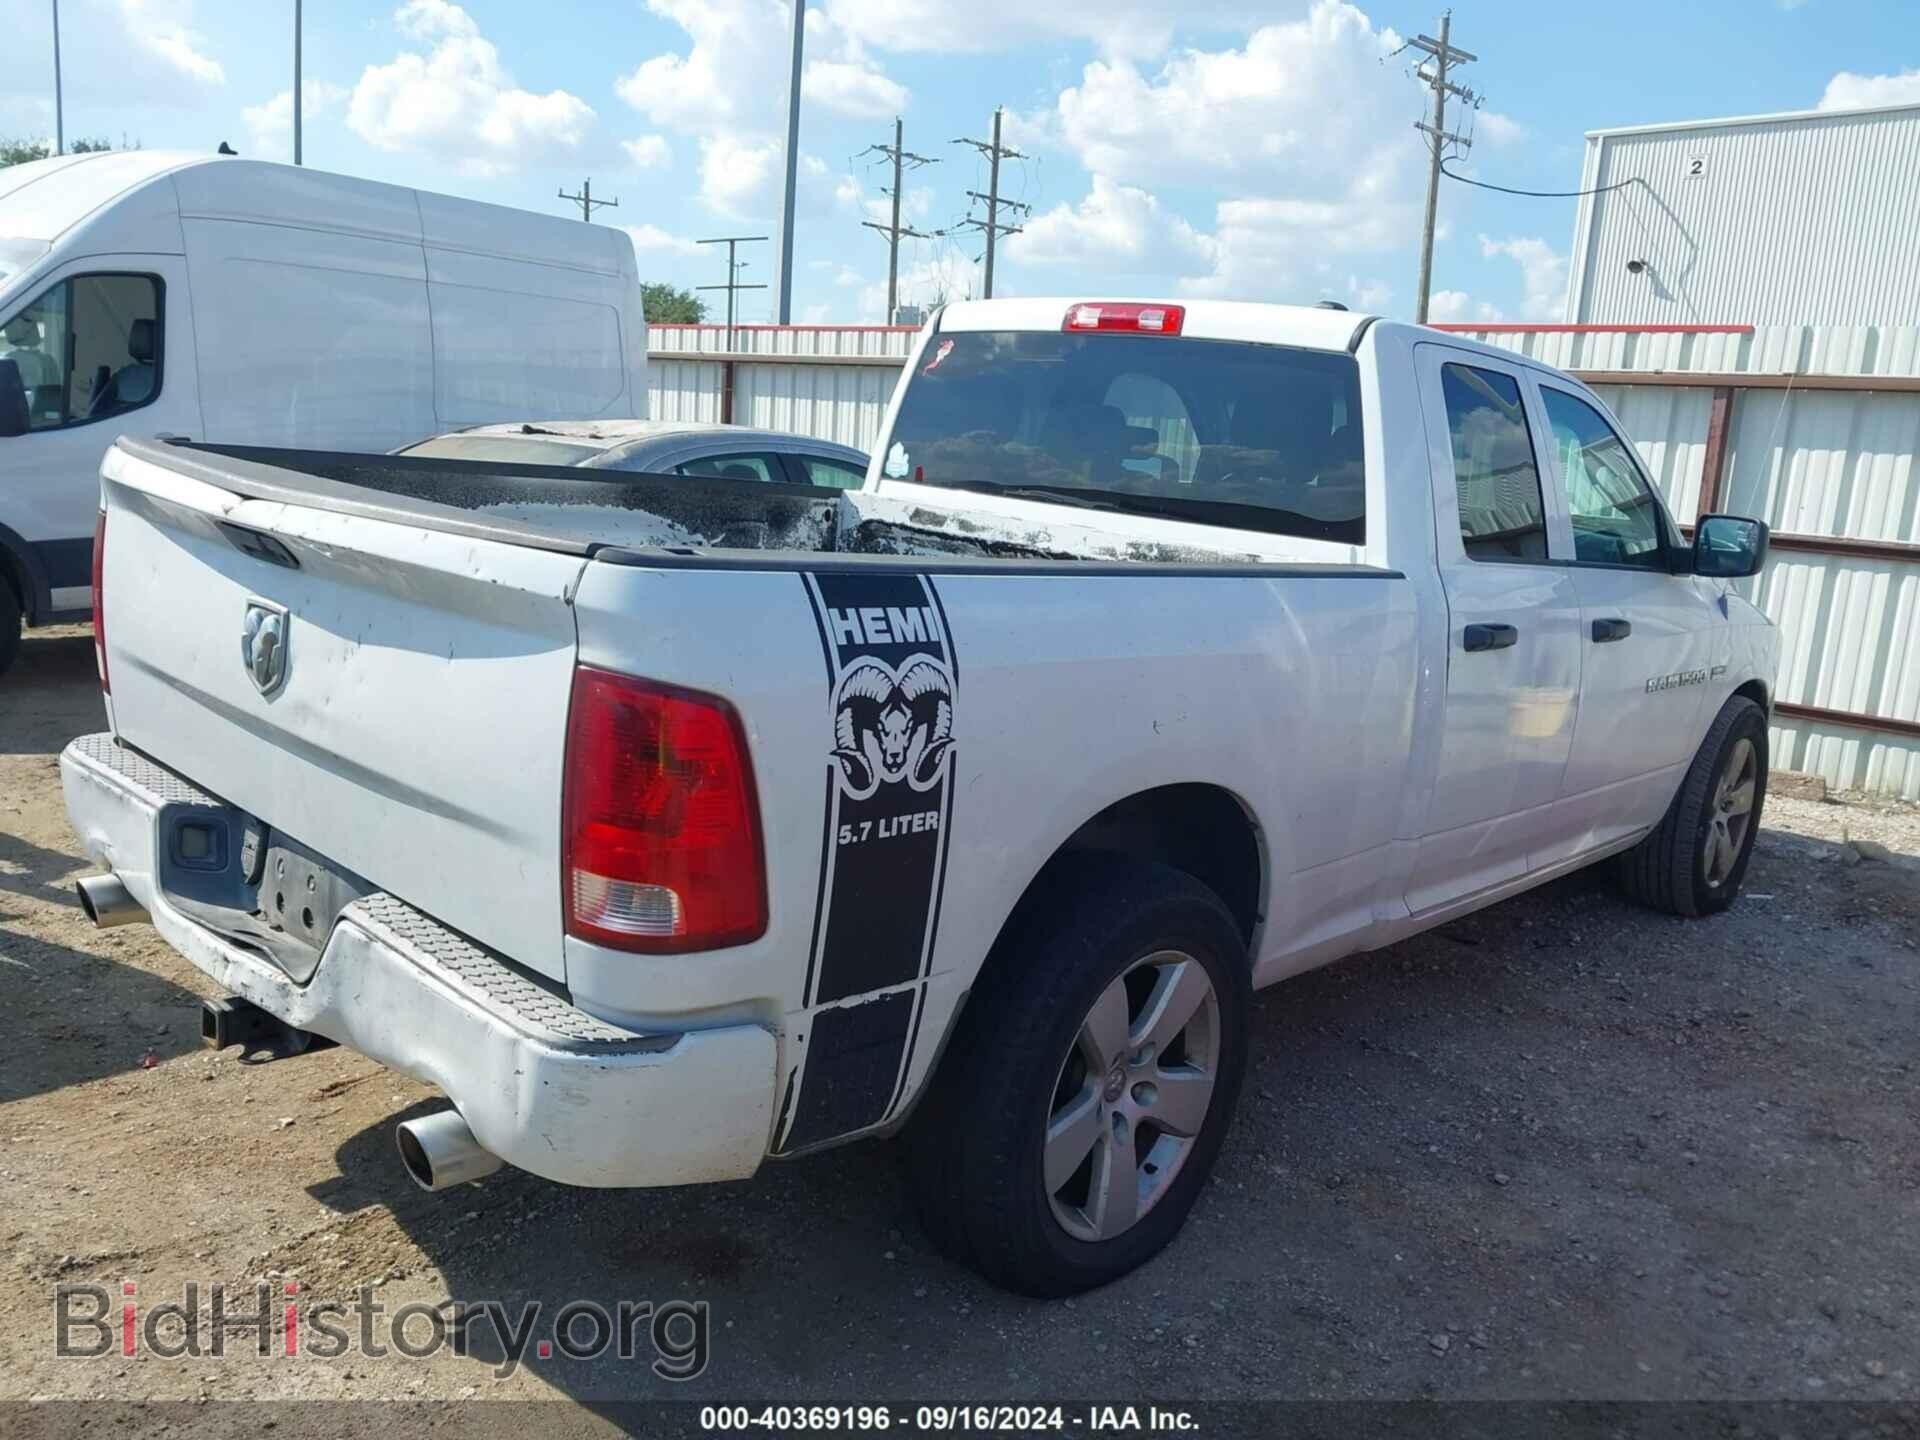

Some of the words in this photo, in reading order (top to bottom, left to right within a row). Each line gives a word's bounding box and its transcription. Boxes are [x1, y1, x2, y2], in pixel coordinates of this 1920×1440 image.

[1690, 160, 1703, 175] 2
[828, 607, 941, 645] HEMI
[838, 821, 873, 845] 5.7
[878, 811, 939, 839] LITER
